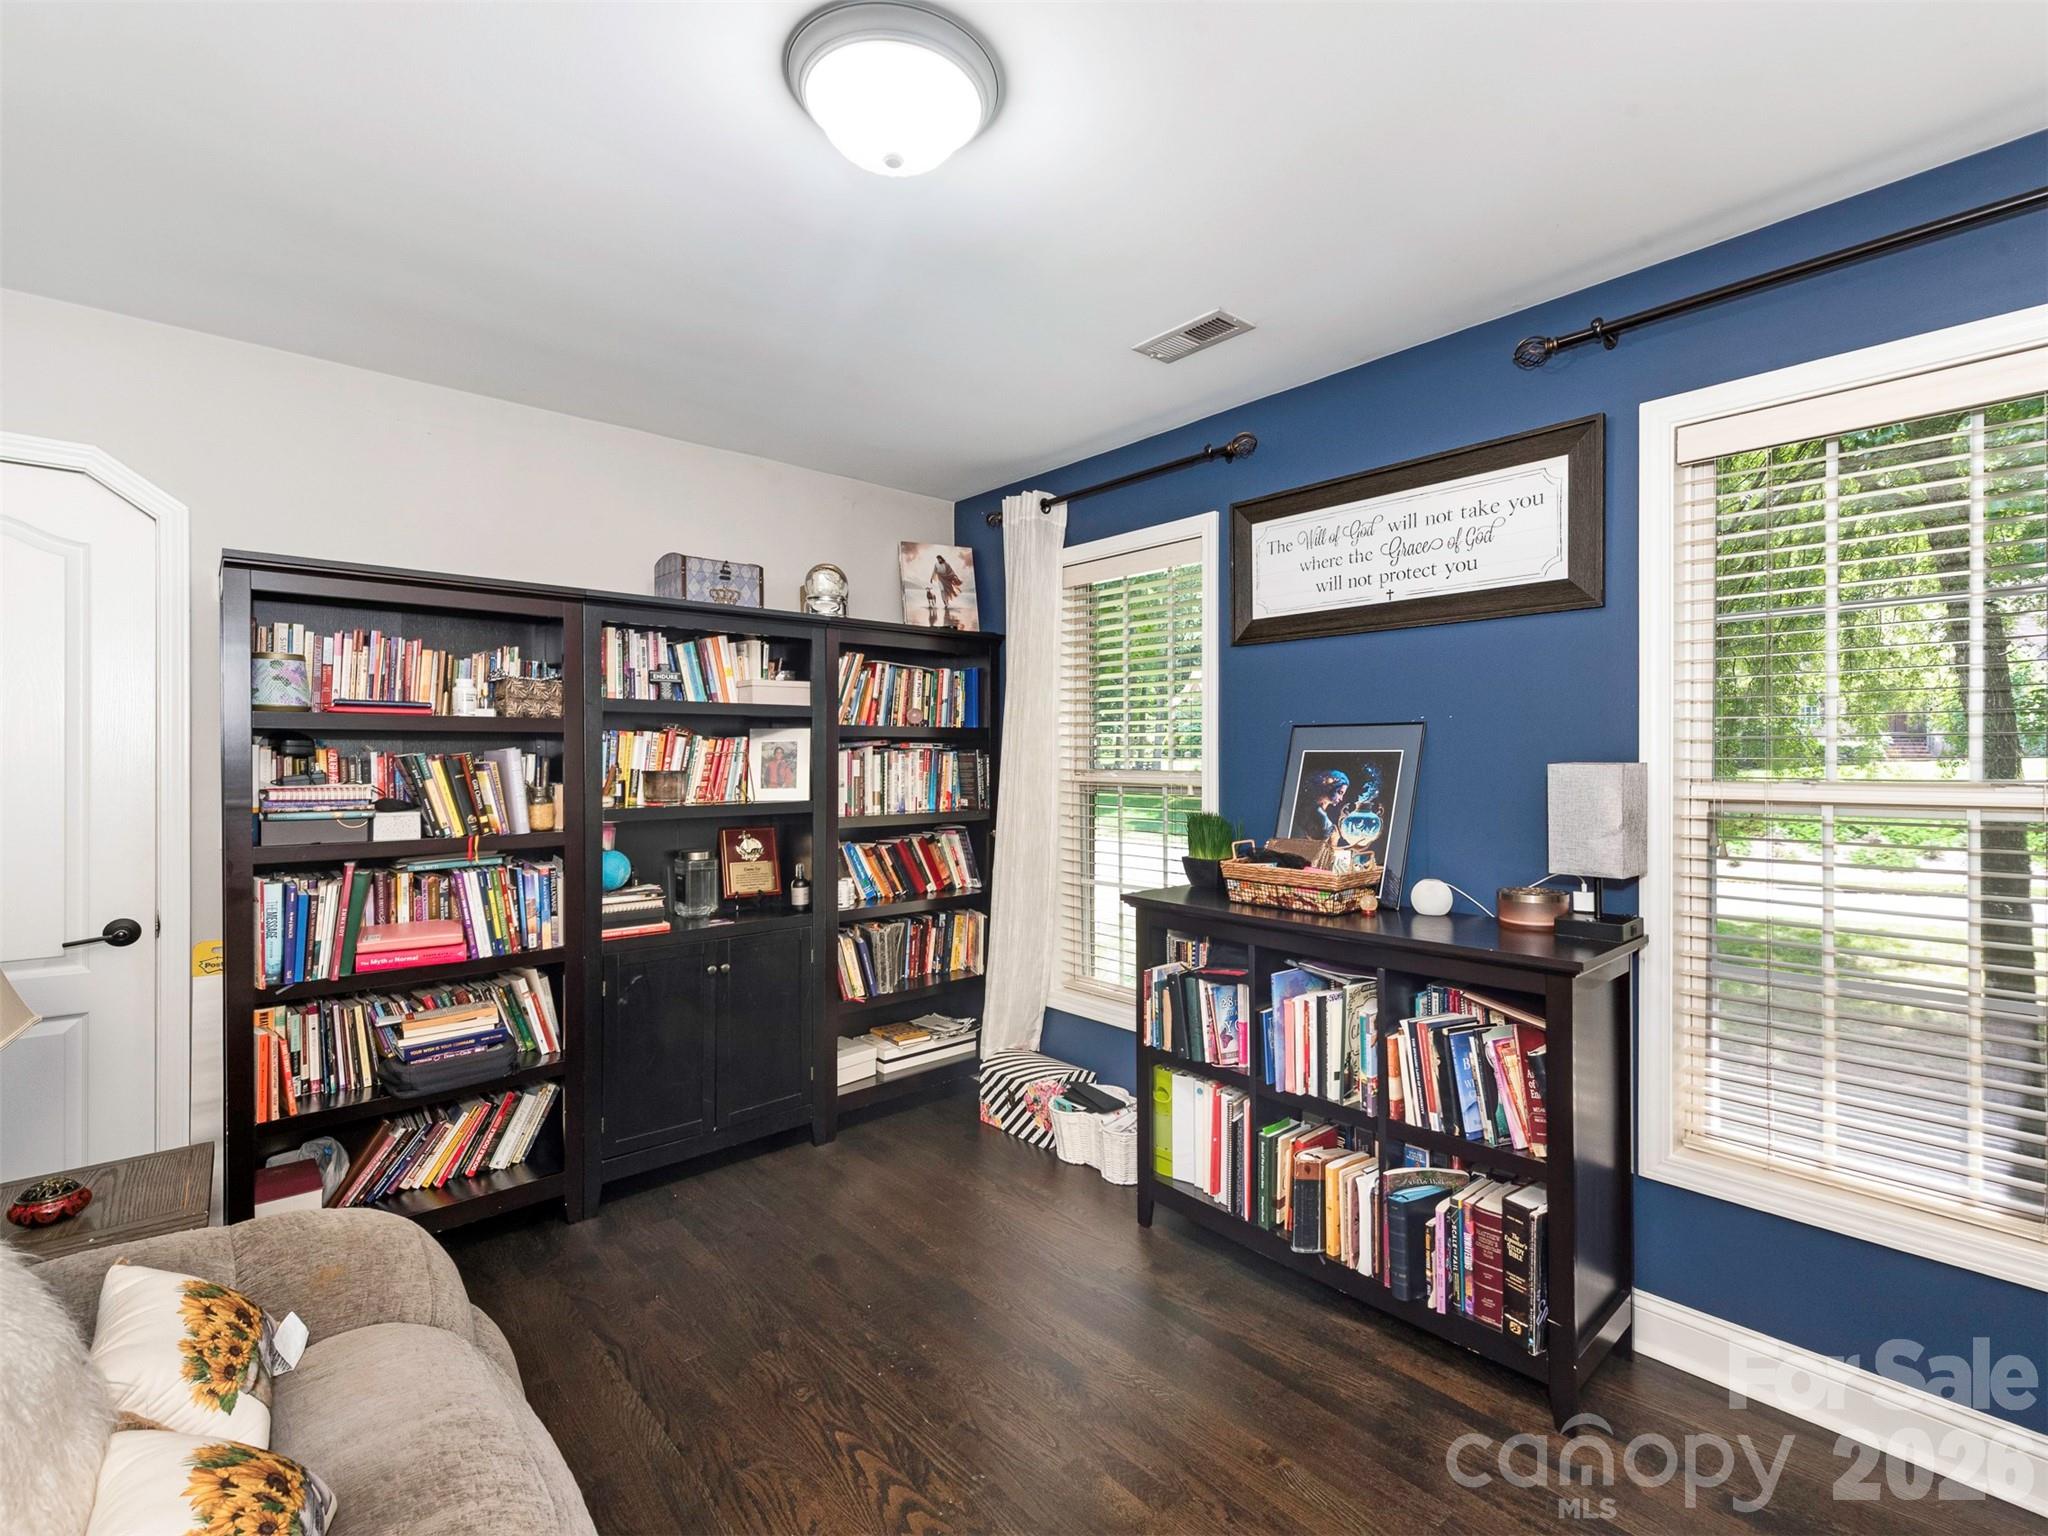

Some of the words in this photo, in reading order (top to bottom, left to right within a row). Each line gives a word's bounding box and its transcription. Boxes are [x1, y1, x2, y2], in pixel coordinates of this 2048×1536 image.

[1266, 539, 1294, 556] The
[1297, 525, 1327, 551] Will
[1328, 525, 1341, 547] of
[1342, 514, 1384, 546] God
[1388, 512, 1417, 532] will
[1425, 510, 1453, 526] not
[1461, 500, 1500, 519] take
[1509, 492, 1545, 516] you
[1300, 556, 1343, 572] where
[1348, 548, 1373, 564] the
[1380, 535, 1443, 567] Grace
[1447, 527, 1463, 553] of
[1465, 516, 1506, 551] God
[1315, 574, 1342, 592] will
[1348, 574, 1372, 589] not
[1380, 563, 1438, 589] protect
[1444, 558, 1478, 579] you
[266, 911, 278, 939] MESSAGE
[370, 958, 388, 966] Myth
[394, 954, 419, 963] Normal
[1463, 1232, 1473, 1271] UNWAVERING
[1511, 1231, 1520, 1241] The
